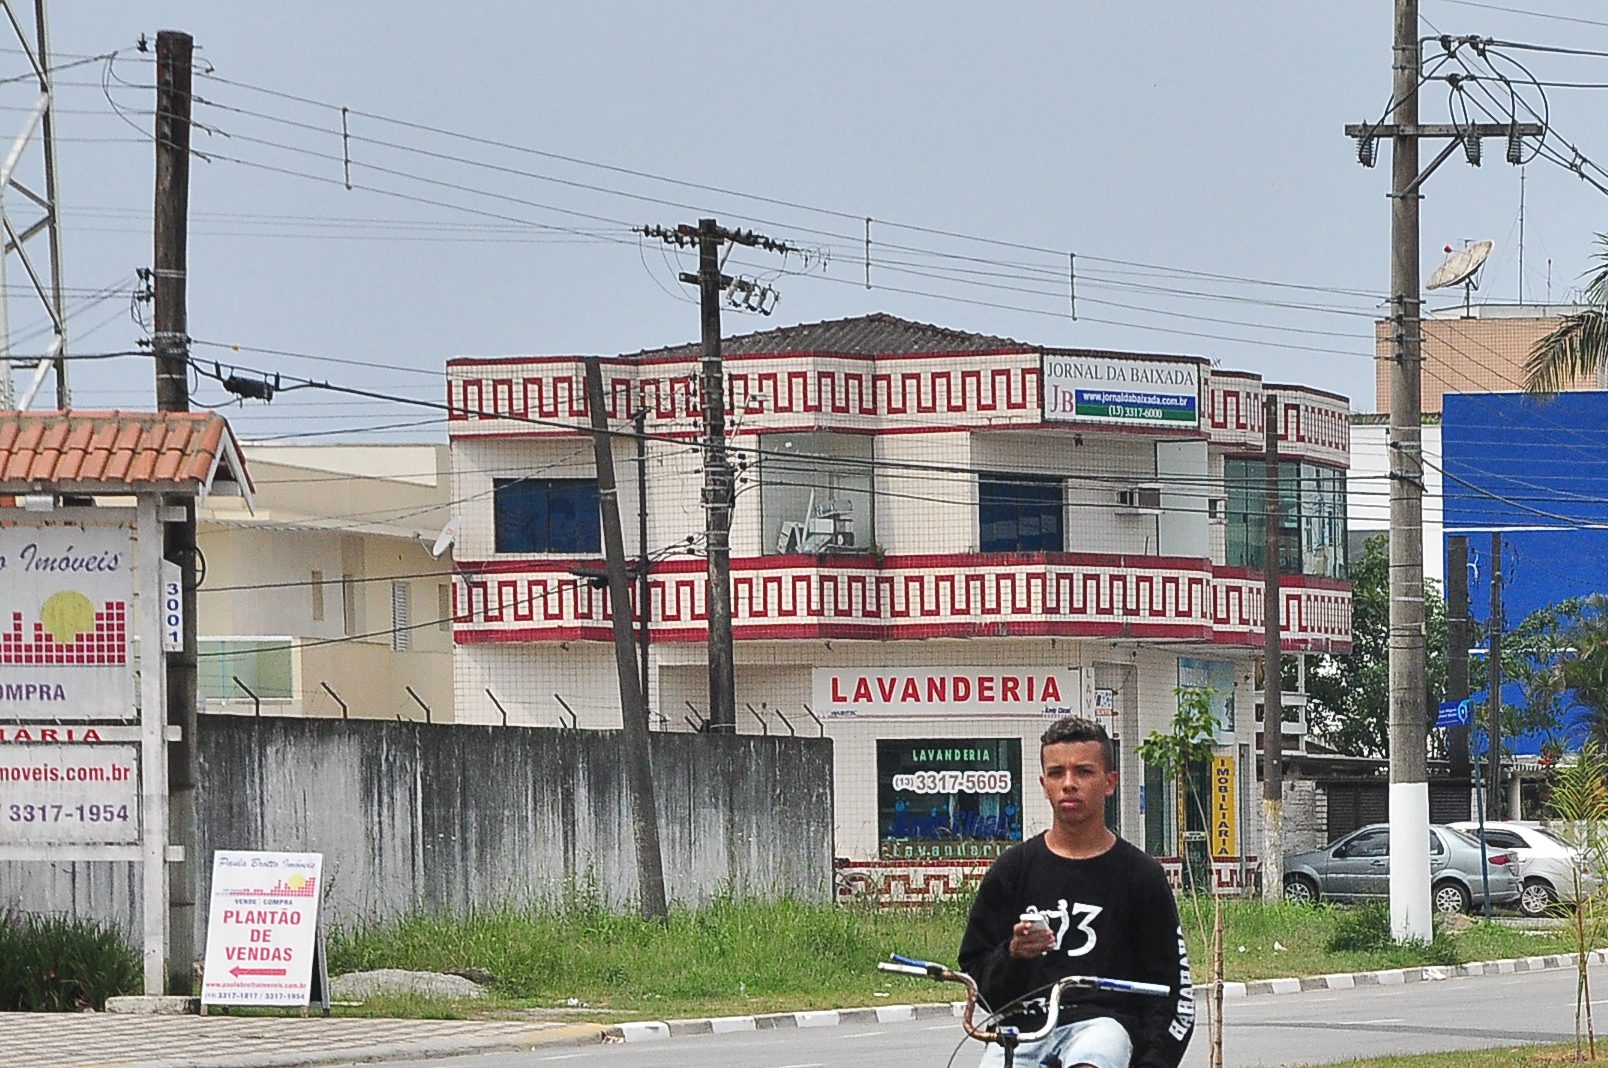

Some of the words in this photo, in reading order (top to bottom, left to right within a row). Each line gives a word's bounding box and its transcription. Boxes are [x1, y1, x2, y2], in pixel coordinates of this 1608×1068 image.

[1048, 362, 1103, 380] JORNAL
[1106, 365, 1127, 382] DA
[1131, 367, 1194, 386] BAIXADA
[1051, 384, 1074, 413] JB
[1083, 391, 1188, 406] www.jornaldabaixada.com.br
[1108, 406, 1124, 418] (13)
[1125, 406, 1163, 419] 3317-6000
[20, 543, 120, 572] Imóveis
[166, 583, 179, 643] 3001
[831, 676, 1062, 703] LAVANDERIA
[912, 749, 990, 761] LAVANDERIA
[895, 777, 914, 787] (13)
[916, 773, 1009, 791] 3317-5605
[9, 804, 129, 822] 3317-1954
[223, 907, 302, 925] PLANTÃO
[250, 929, 272, 943] DE
[225, 946, 293, 962] VENDAS
